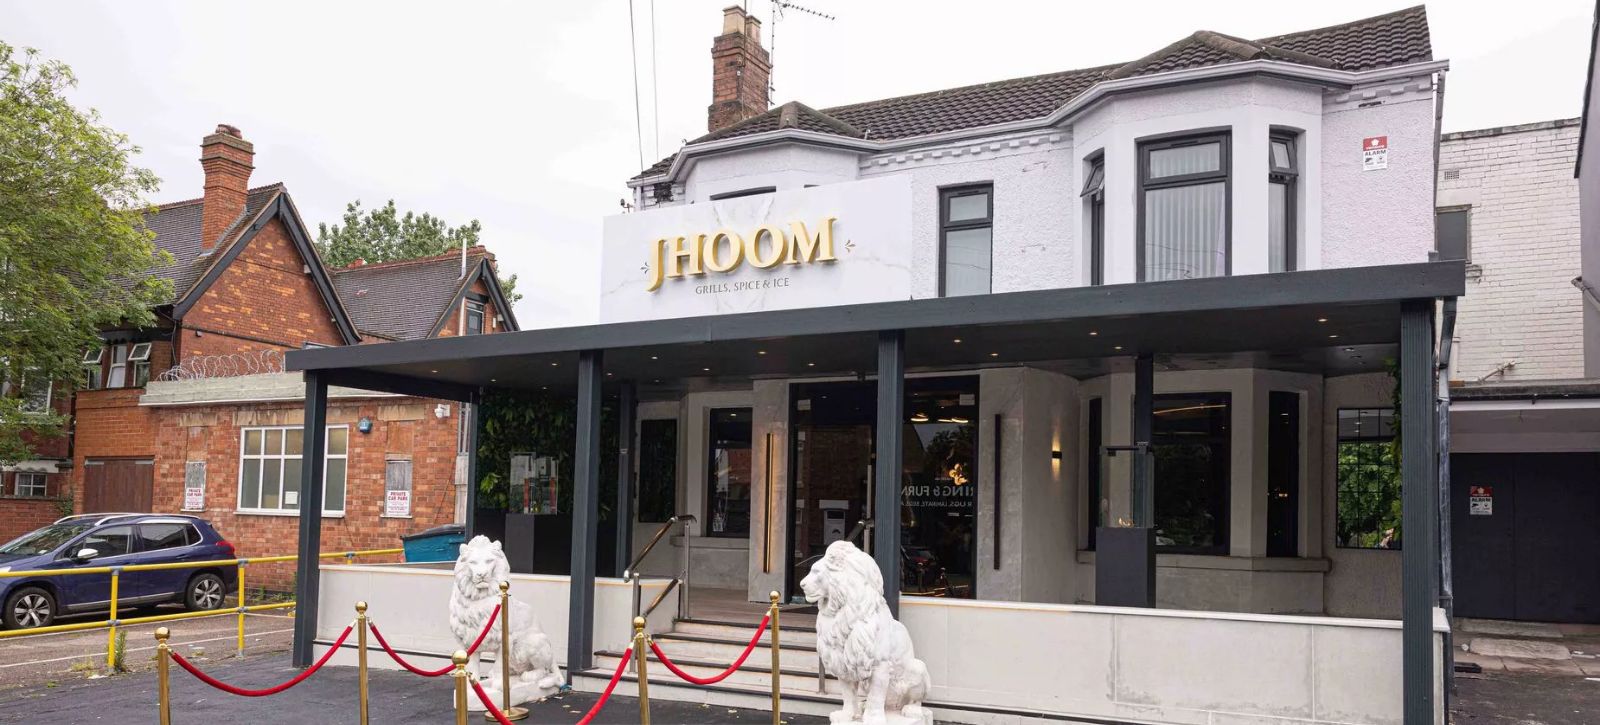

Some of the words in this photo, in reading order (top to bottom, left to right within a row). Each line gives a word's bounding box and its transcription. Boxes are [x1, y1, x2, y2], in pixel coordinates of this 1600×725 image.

[646, 217, 837, 292] JHOOM
[695, 283, 731, 295] GRILLS,
[734, 280, 761, 291] SPICE
[762, 279, 771, 289] &
[773, 277, 790, 287] ICE
